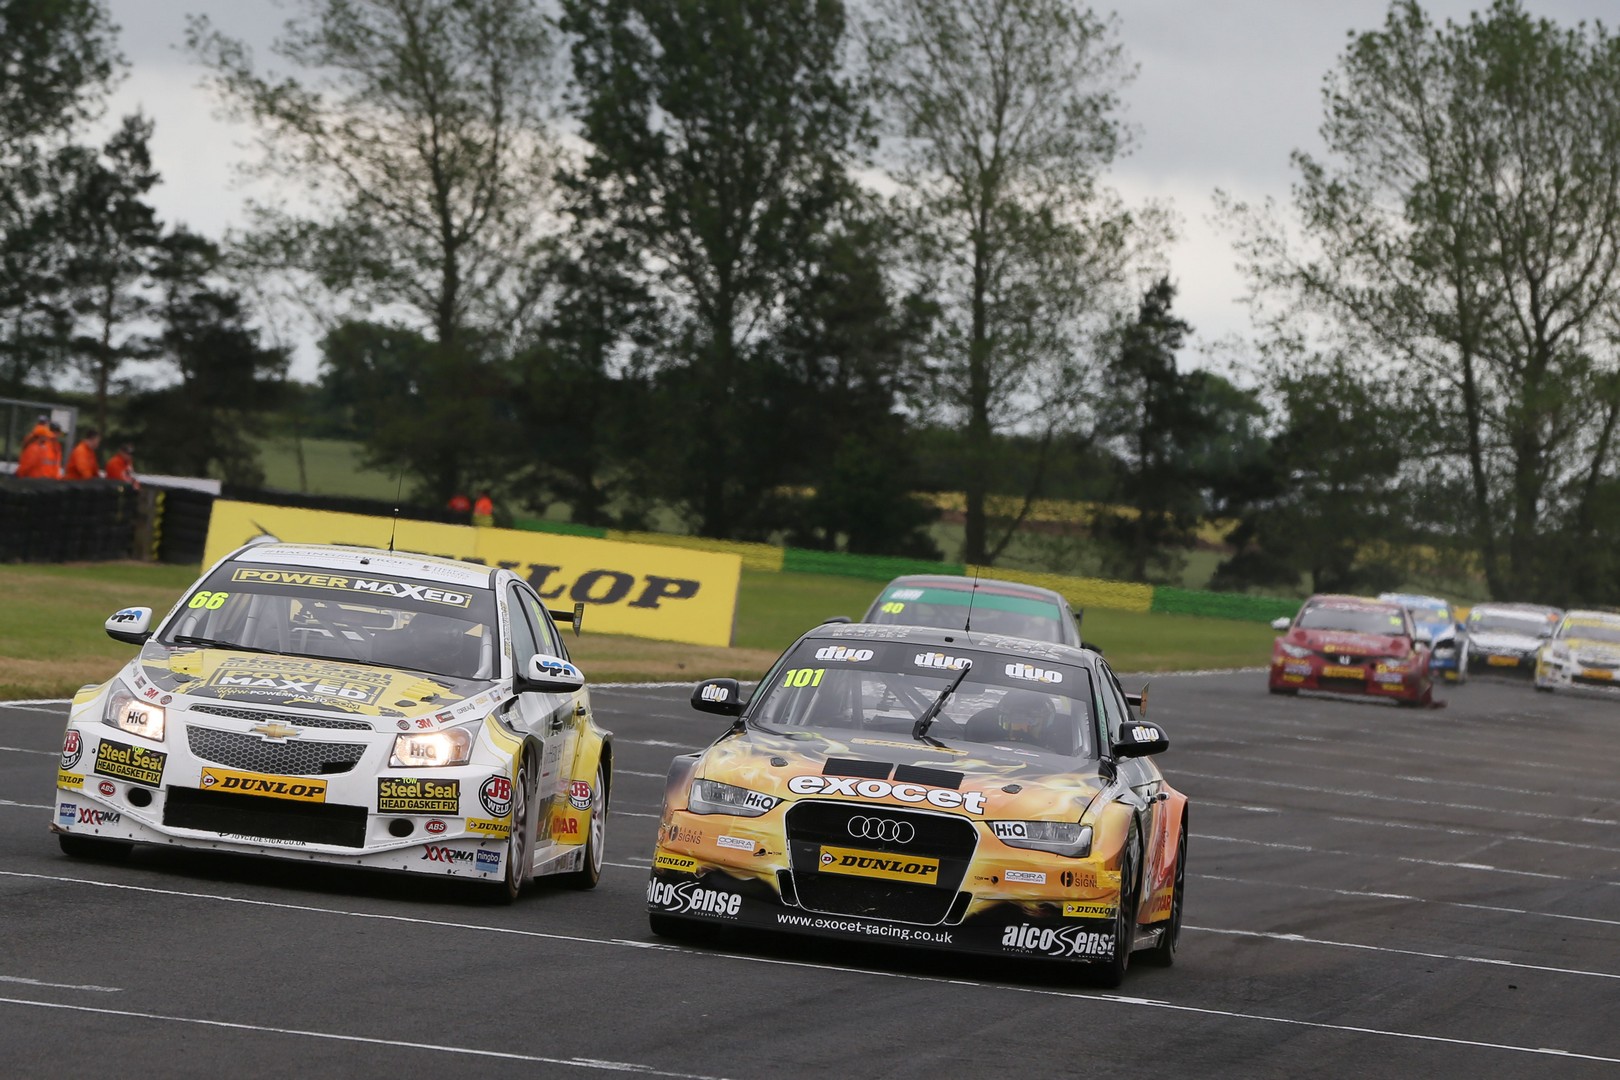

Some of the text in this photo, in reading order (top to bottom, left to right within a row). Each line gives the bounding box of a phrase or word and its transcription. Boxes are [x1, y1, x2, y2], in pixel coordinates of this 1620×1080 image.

[239, 570, 467, 604] POWER MAXED
[188, 591, 229, 610] 66
[881, 602, 905, 614] 40
[815, 646, 874, 662] duo
[914, 652, 973, 670] duo
[224, 671, 372, 691] POWER
[783, 668, 826, 687] 101
[1005, 663, 1063, 683] duo
[144, 687, 159, 699] 3M
[219, 677, 367, 700] MAXED
[701, 684, 728, 702] duo
[126, 711, 149, 724] HiQ
[415, 718, 433, 729] 3M
[1132, 726, 1160, 742] duo
[98, 743, 163, 771] Steel Seal
[131, 745, 144, 753] TOW
[410, 740, 436, 759] HiQ
[97, 761, 160, 783] HEAD GASKET FIX
[100, 785, 114, 794] ABS
[221, 776, 325, 797] DUNLOP
[380, 782, 458, 798] Steel Seal
[487, 777, 512, 801] J-B
[570, 781, 589, 798] J-B
[571, 797, 590, 808] WELD
[745, 793, 774, 810] HiQ
[788, 775, 986, 815] exocet
[381, 799, 456, 810] HEAD GASKET FIX
[487, 799, 510, 814] WELD
[428, 823, 445, 831] ABS
[995, 823, 1026, 838] HiQ
[678, 833, 701, 845] SIGNS
[477, 852, 499, 864] ningbo
[656, 855, 694, 868] DUNLOP
[839, 855, 938, 876] DUNLOP
[1006, 871, 1044, 880] COBRA
[777, 913, 953, 944] www.exocet-racing.co.uk
